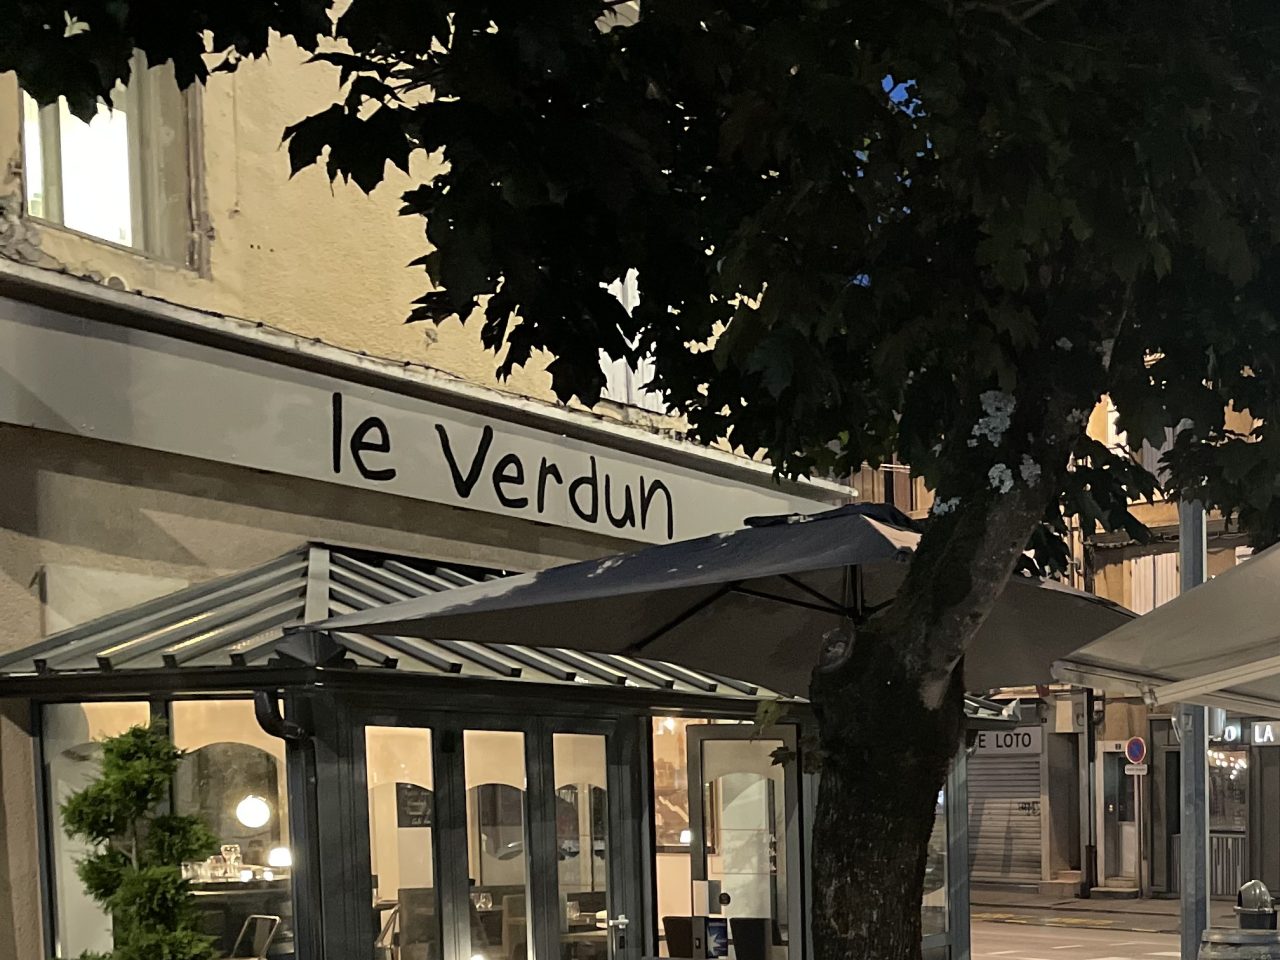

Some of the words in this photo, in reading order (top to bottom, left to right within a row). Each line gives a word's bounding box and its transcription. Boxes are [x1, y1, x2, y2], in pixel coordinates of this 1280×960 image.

[332, 392, 397, 481] le
[434, 423, 674, 540] Verdun
[995, 732, 1032, 748] LOTO
[1254, 724, 1274, 743] LA
